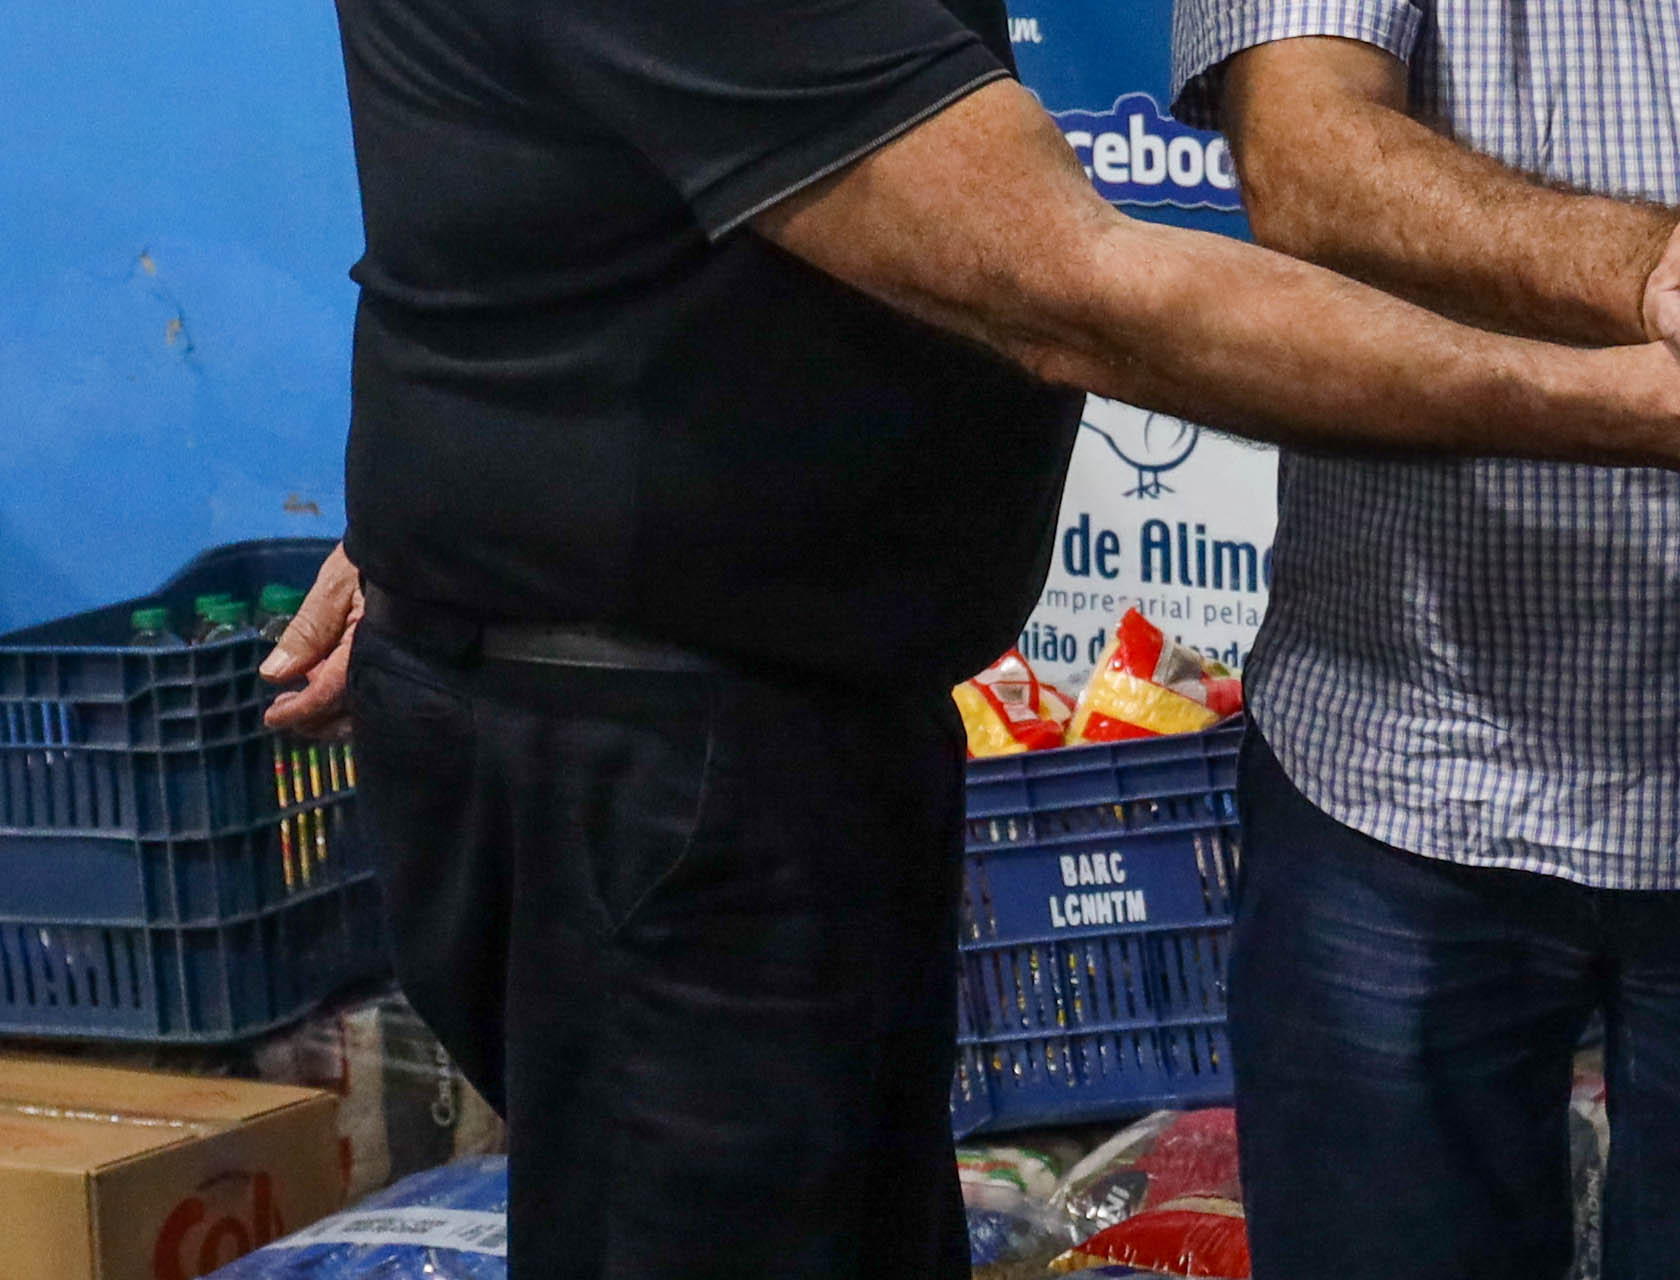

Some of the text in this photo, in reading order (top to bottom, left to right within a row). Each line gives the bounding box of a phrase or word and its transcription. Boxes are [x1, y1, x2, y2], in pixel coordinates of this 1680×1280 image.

[1063, 513, 1121, 578] de
[1037, 588, 1191, 619] mprearial
[1060, 852, 1127, 888] BARC
